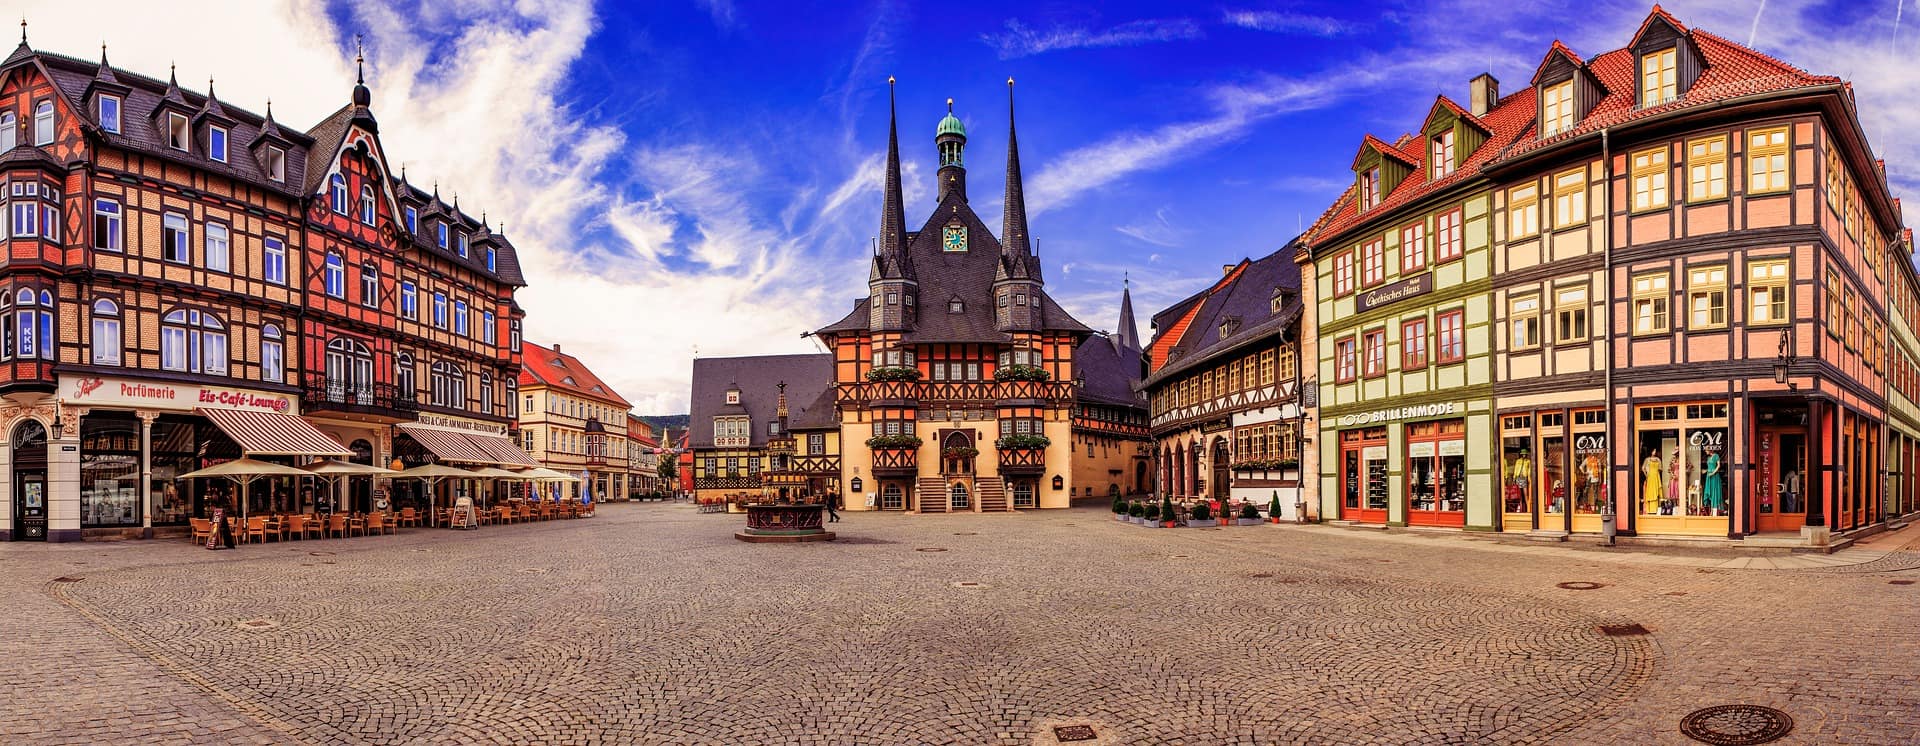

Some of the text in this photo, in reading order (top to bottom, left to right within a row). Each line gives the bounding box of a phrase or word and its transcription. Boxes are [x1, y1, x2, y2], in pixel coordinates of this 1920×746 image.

[1403, 285, 1420, 297] Haus
[23, 327, 32, 352] KKH
[120, 383, 175, 400] Parfümerie
[198, 389, 287, 411] Eis-Café-Lounge
[1372, 402, 1454, 422] BRILLENMODE
